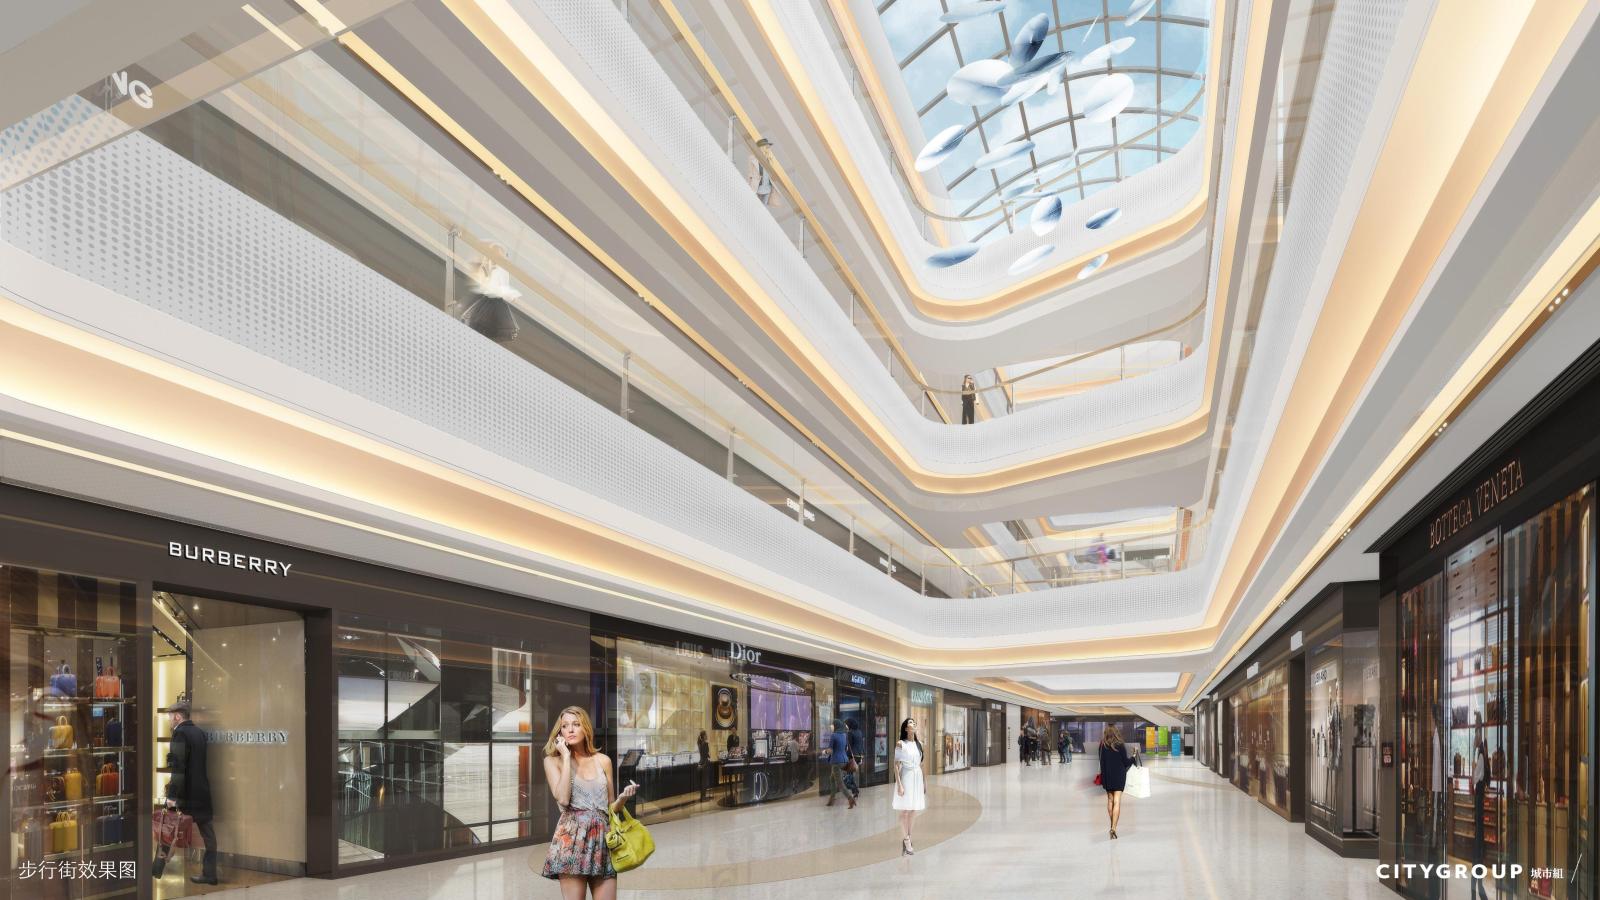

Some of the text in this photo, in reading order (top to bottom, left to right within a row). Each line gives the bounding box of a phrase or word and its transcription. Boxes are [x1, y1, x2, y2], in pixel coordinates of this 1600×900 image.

[1429, 459, 1524, 549] BOTTEGA VENETA
[168, 541, 292, 577] BURBERRY
[730, 641, 762, 664] Dior
[205, 730, 288, 745] BURBERRY
